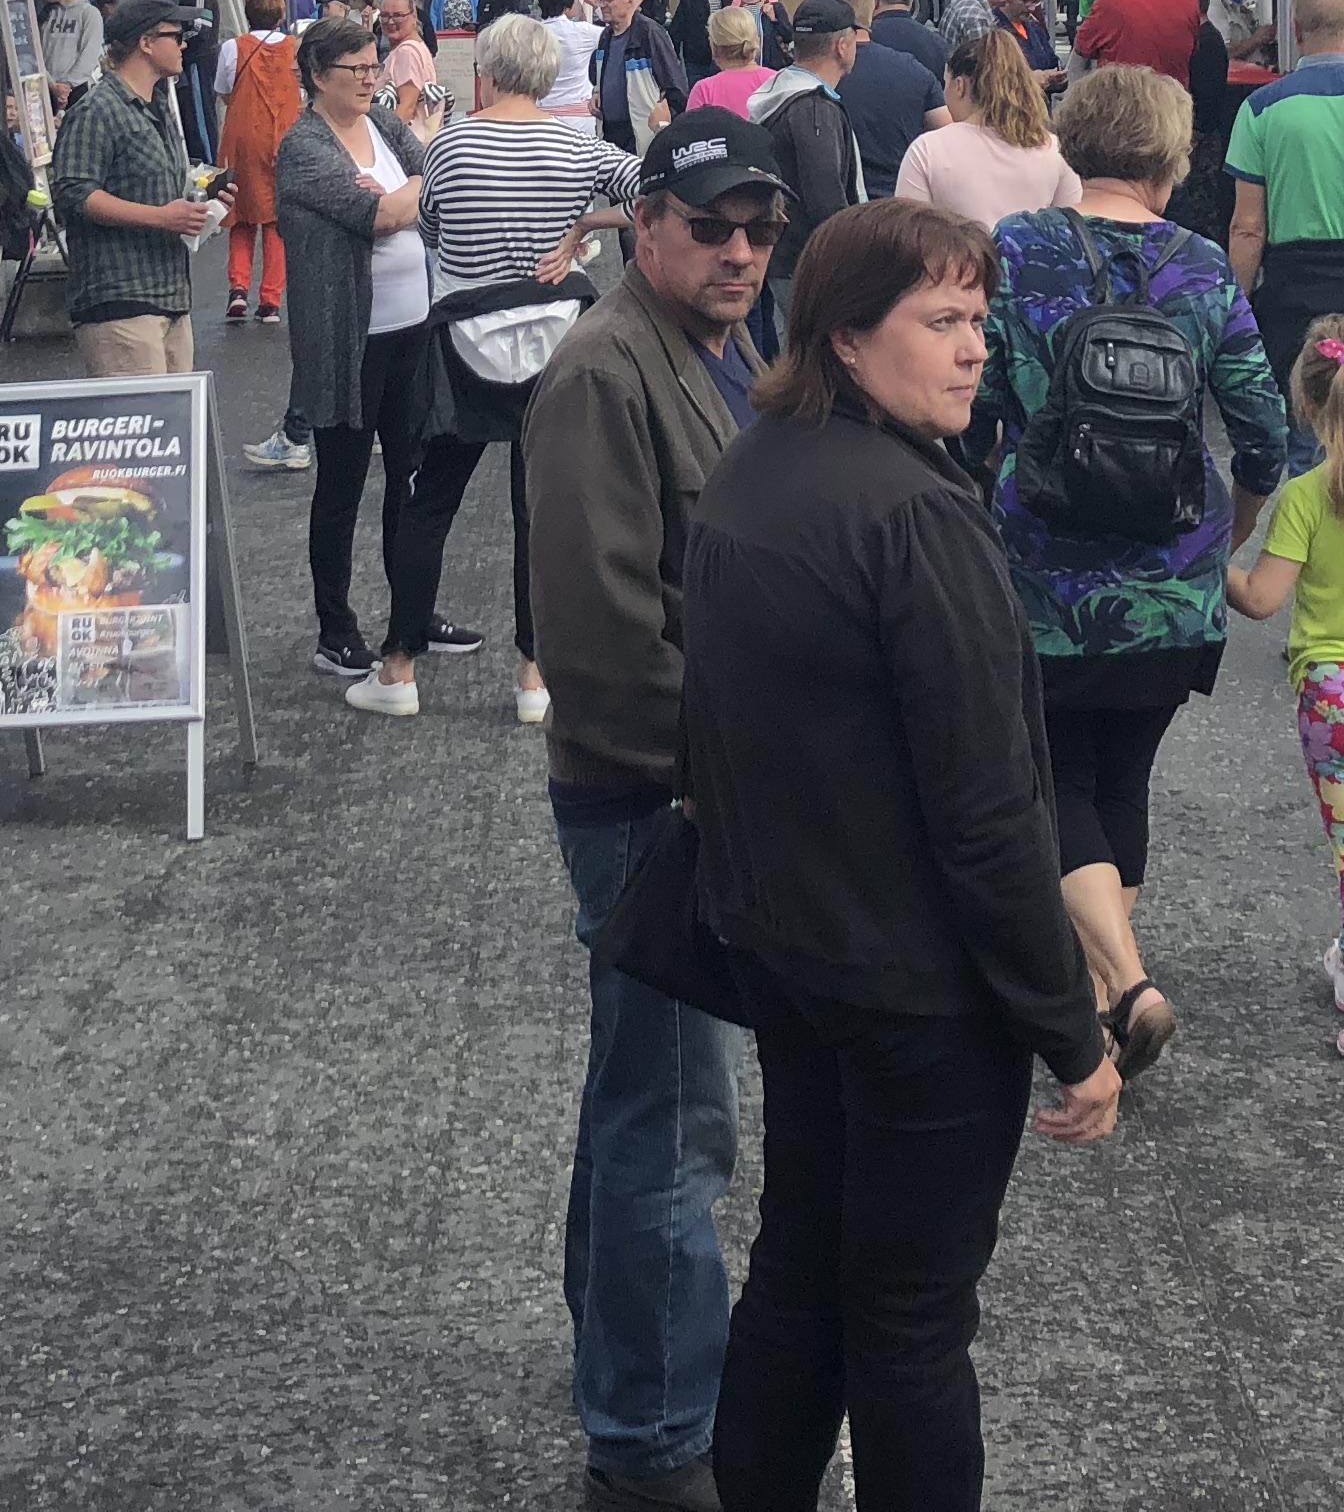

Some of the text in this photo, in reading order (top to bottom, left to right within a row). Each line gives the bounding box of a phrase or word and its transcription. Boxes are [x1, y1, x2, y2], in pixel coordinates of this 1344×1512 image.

[51, 415, 165, 440] BURGERI-
[50, 436, 182, 463] RAVINTOLA
[92, 465, 187, 480] RUOKBURGER.FI
